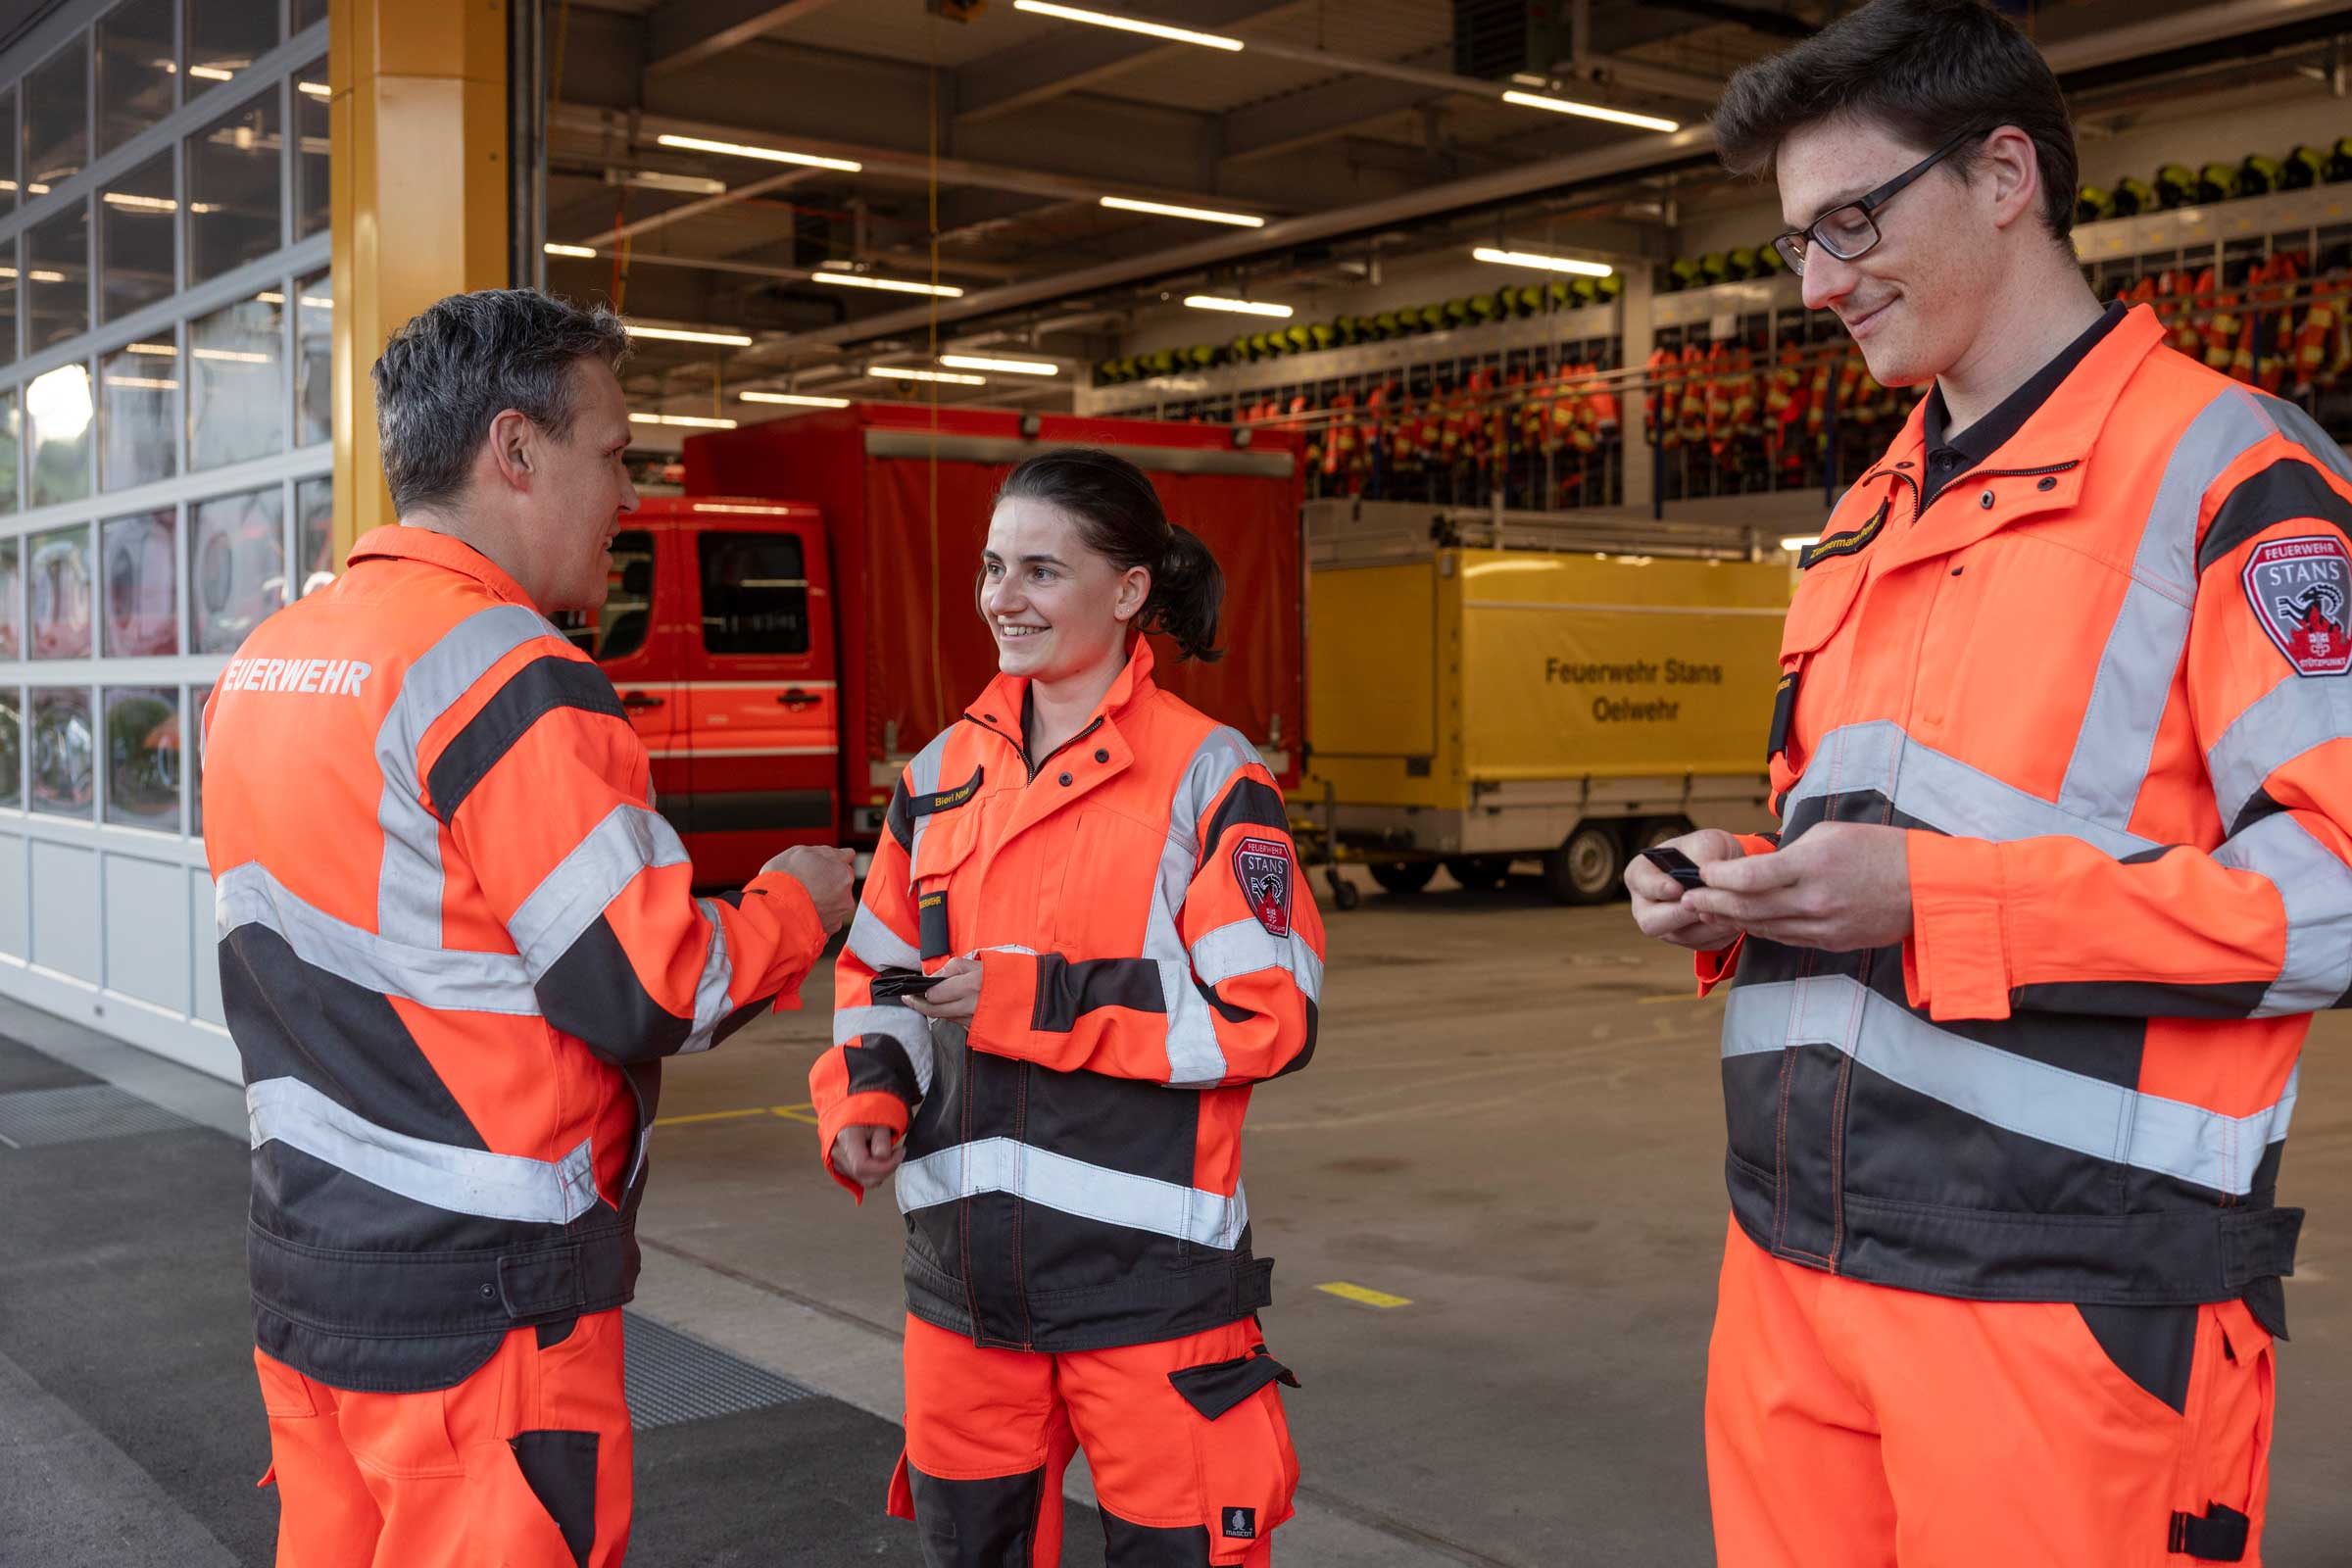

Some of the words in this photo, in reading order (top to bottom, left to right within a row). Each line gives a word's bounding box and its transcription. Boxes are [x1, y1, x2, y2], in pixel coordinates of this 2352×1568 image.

[2264, 542, 2336, 561] FEUERWEHR
[2269, 561, 2340, 586] STANS
[223, 658, 372, 697] EUERWEHR
[1545, 658, 1658, 684] Feuerwehr
[1665, 658, 1723, 684] Stans
[1592, 696, 1680, 722] Oelwehr
[1248, 843, 1284, 855] FEUERWEHR
[1248, 856, 1284, 874] STANS
